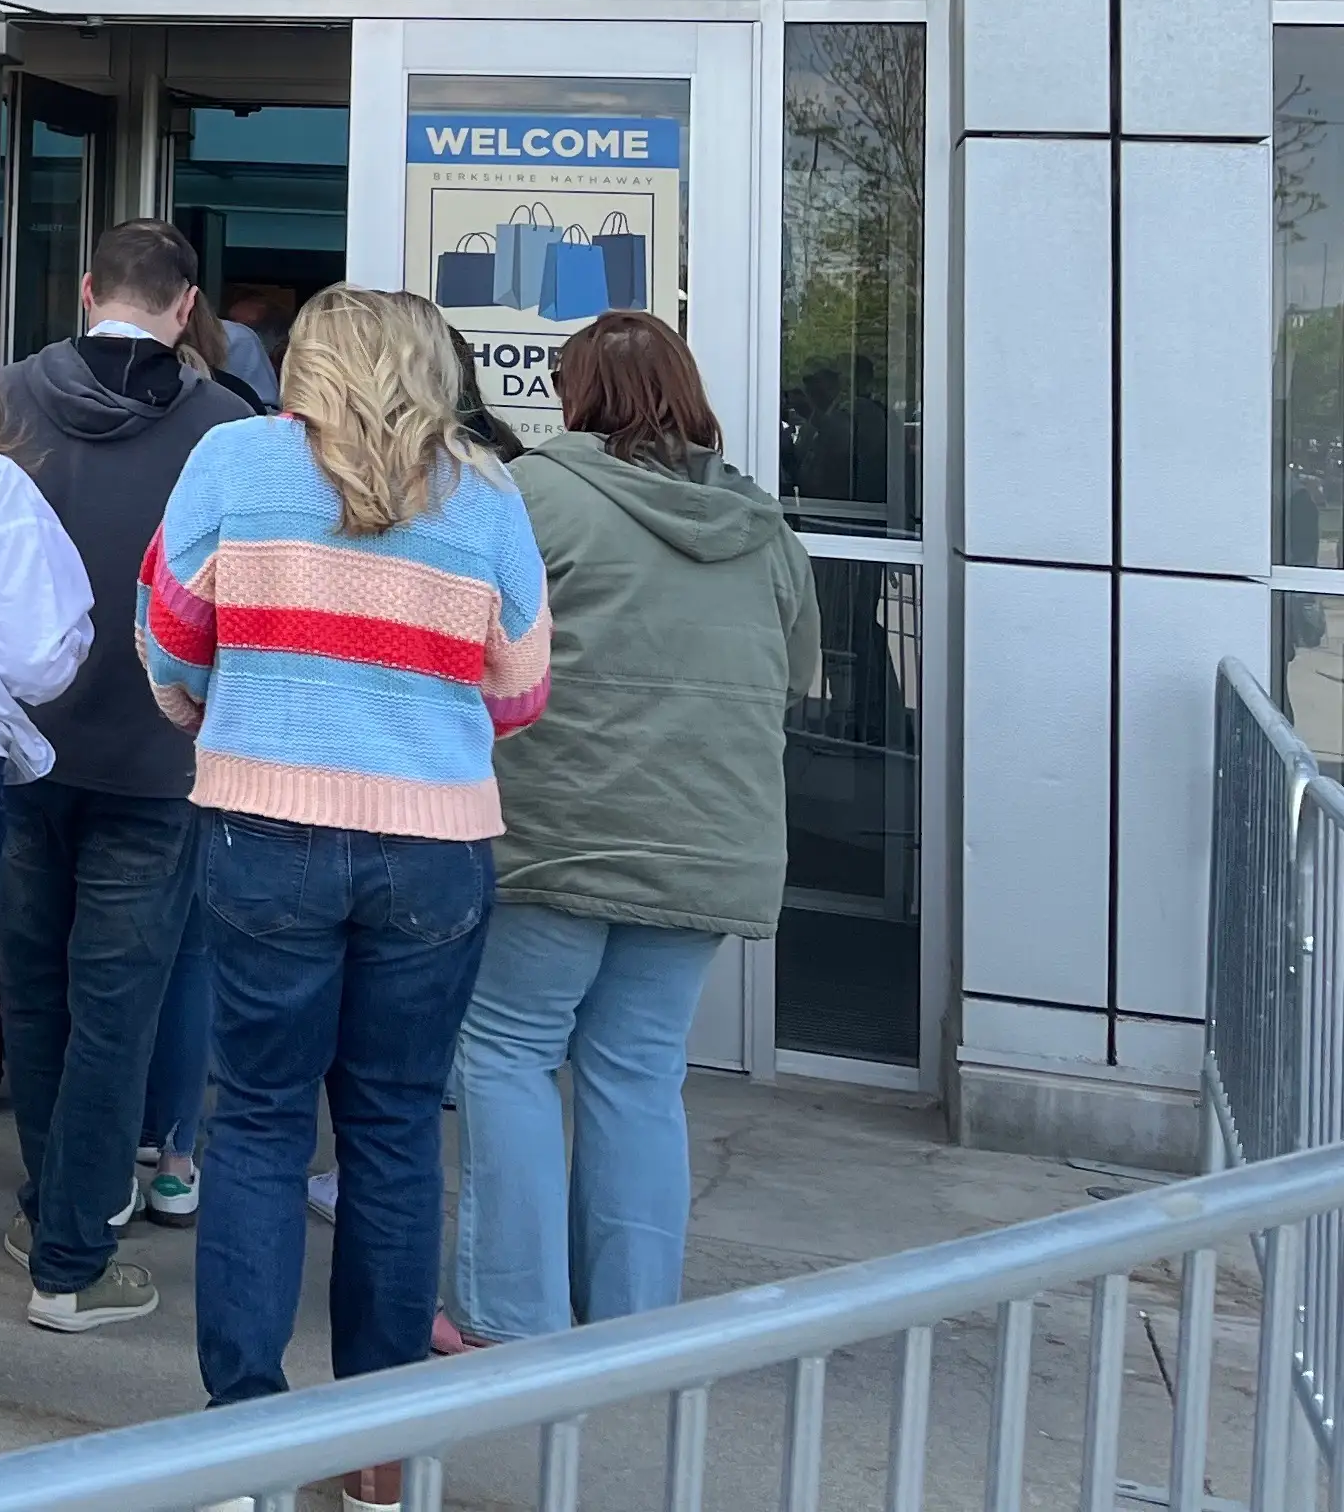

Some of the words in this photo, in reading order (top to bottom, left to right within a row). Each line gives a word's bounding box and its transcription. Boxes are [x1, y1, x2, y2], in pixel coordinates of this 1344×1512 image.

[425, 127, 649, 159] WELCOME
[433, 172, 537, 183] BERKSHIRE
[551, 175, 654, 186] HATHAWAY
[503, 374, 550, 399] DA
